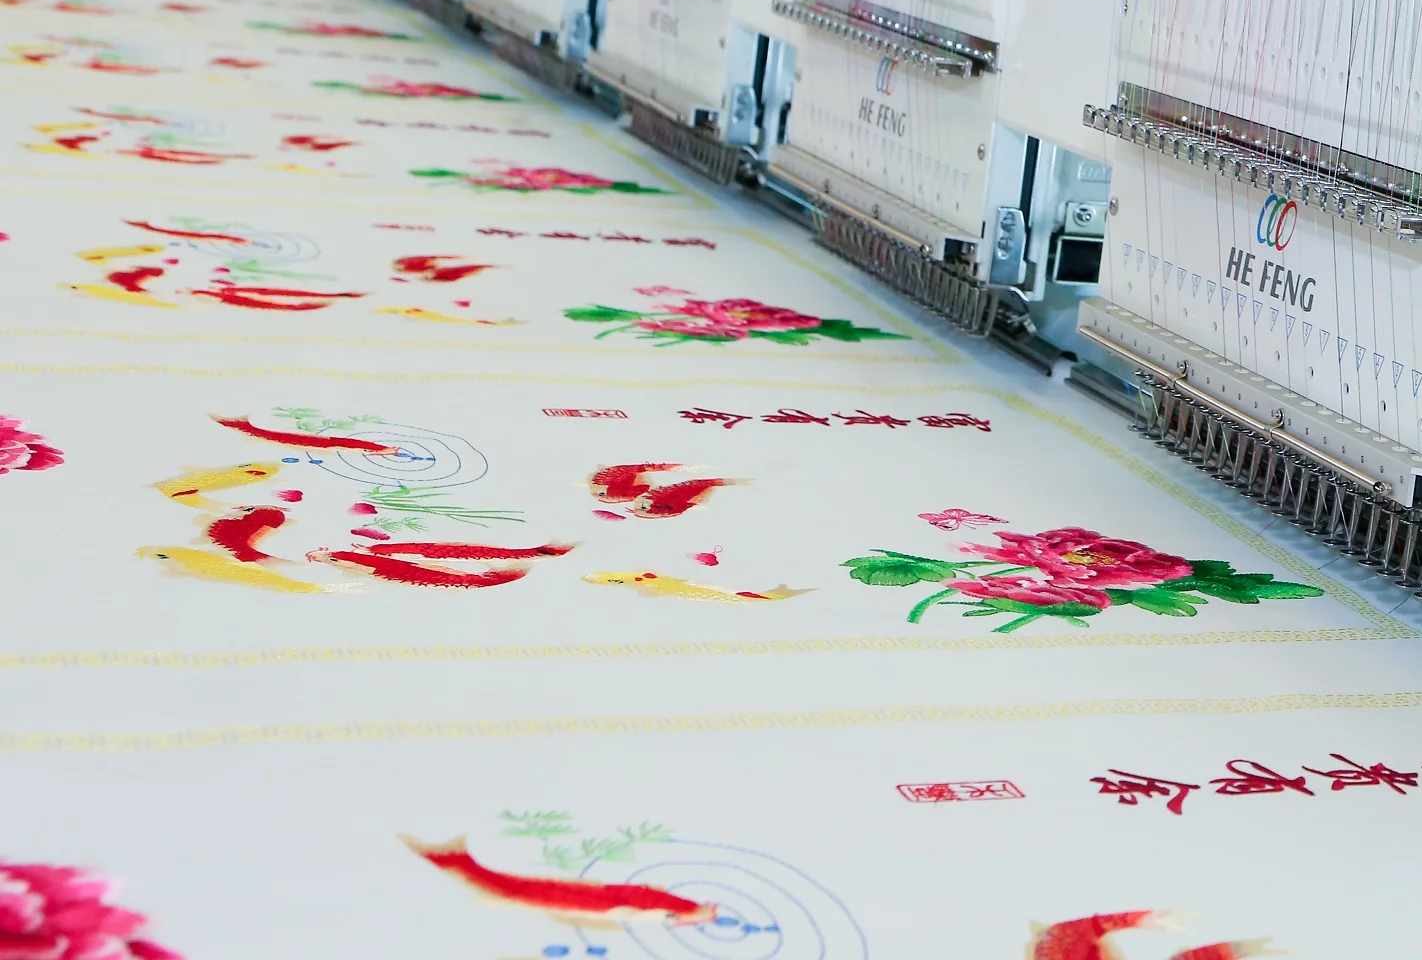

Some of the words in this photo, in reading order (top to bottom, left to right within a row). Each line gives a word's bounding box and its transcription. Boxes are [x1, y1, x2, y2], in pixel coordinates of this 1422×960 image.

[858, 96, 874, 124] HE
[876, 104, 907, 138] FENG
[1225, 246, 1256, 287] HE
[1258, 259, 1317, 313] FENG
